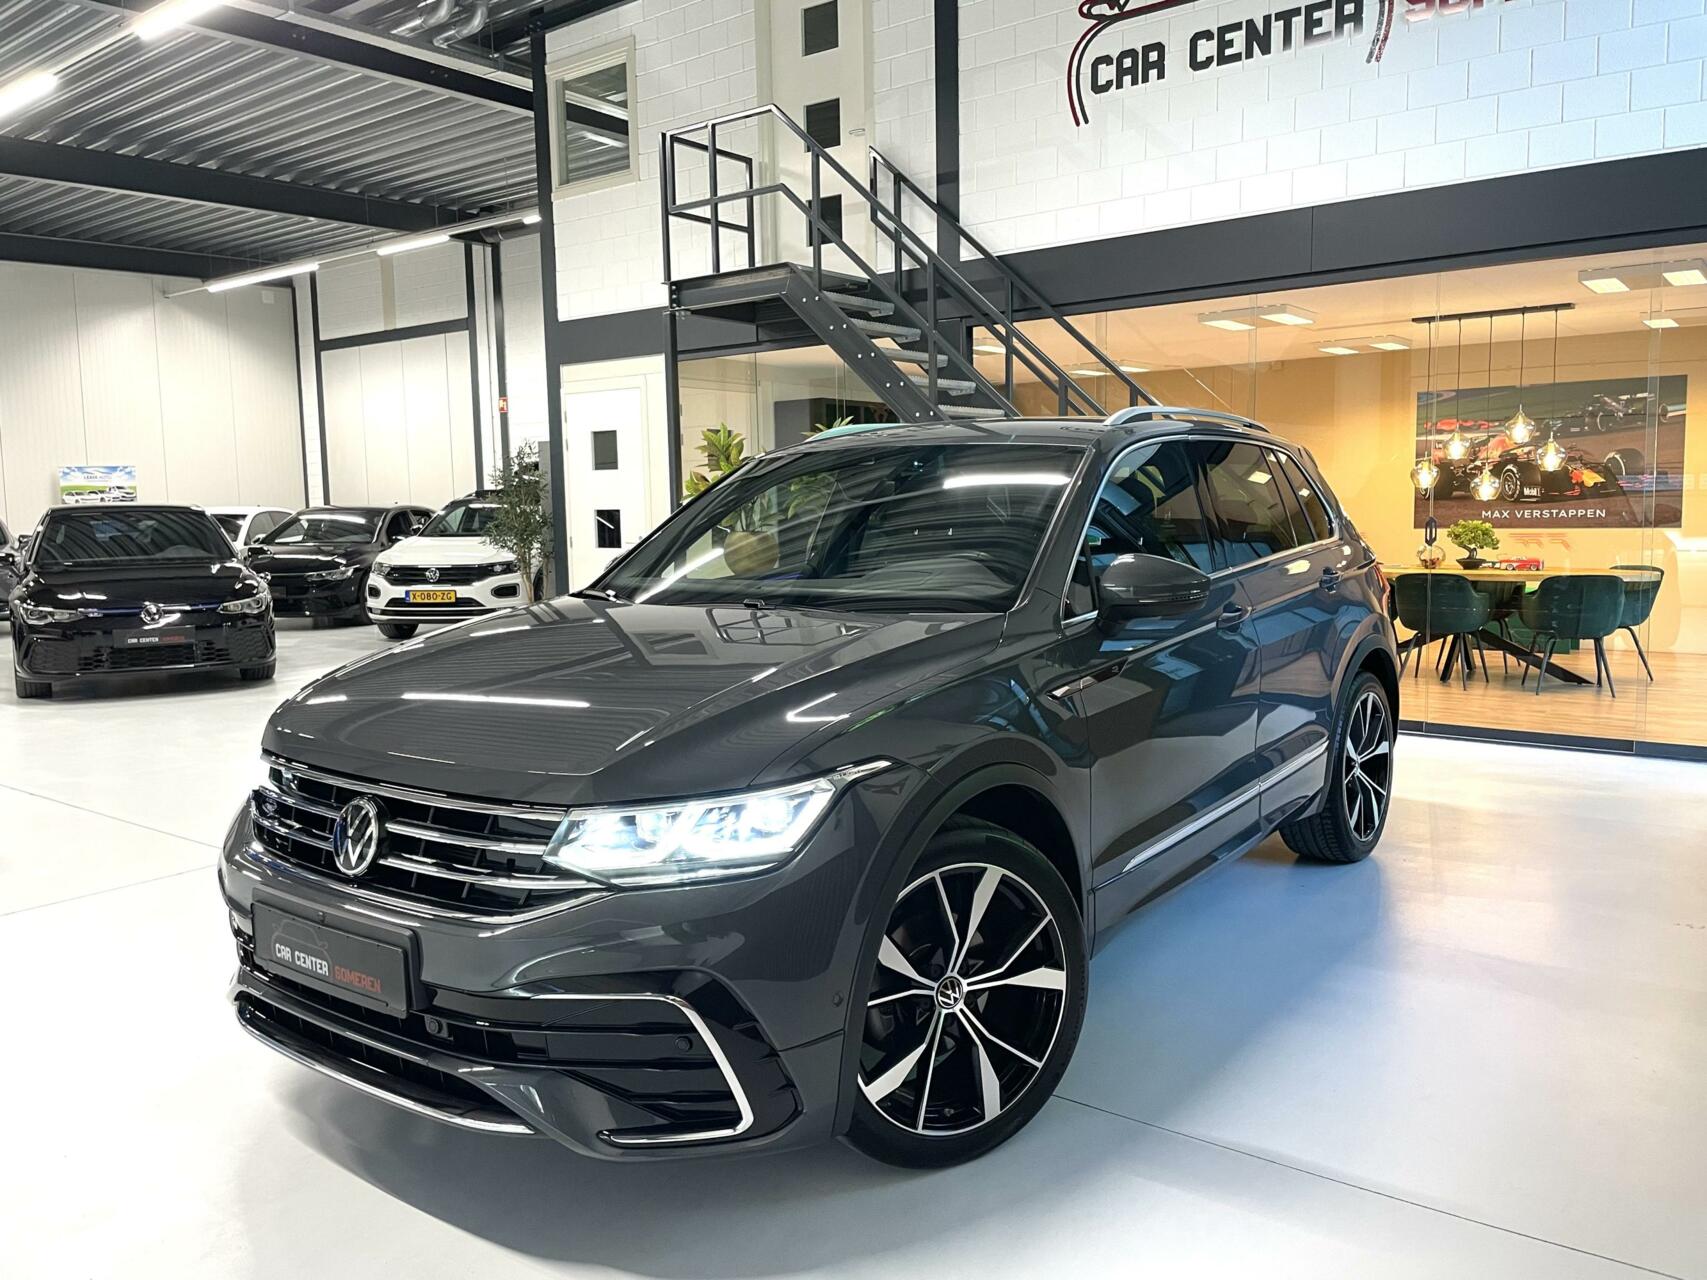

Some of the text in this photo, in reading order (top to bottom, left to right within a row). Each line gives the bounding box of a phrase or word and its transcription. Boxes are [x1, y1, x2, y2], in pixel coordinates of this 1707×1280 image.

[1090, 0, 1364, 95] CAR CENTER
[1481, 509, 1606, 519] MAX VERSTAPPEN
[275, 943, 381, 993] CAR CENTER SOMEREN
